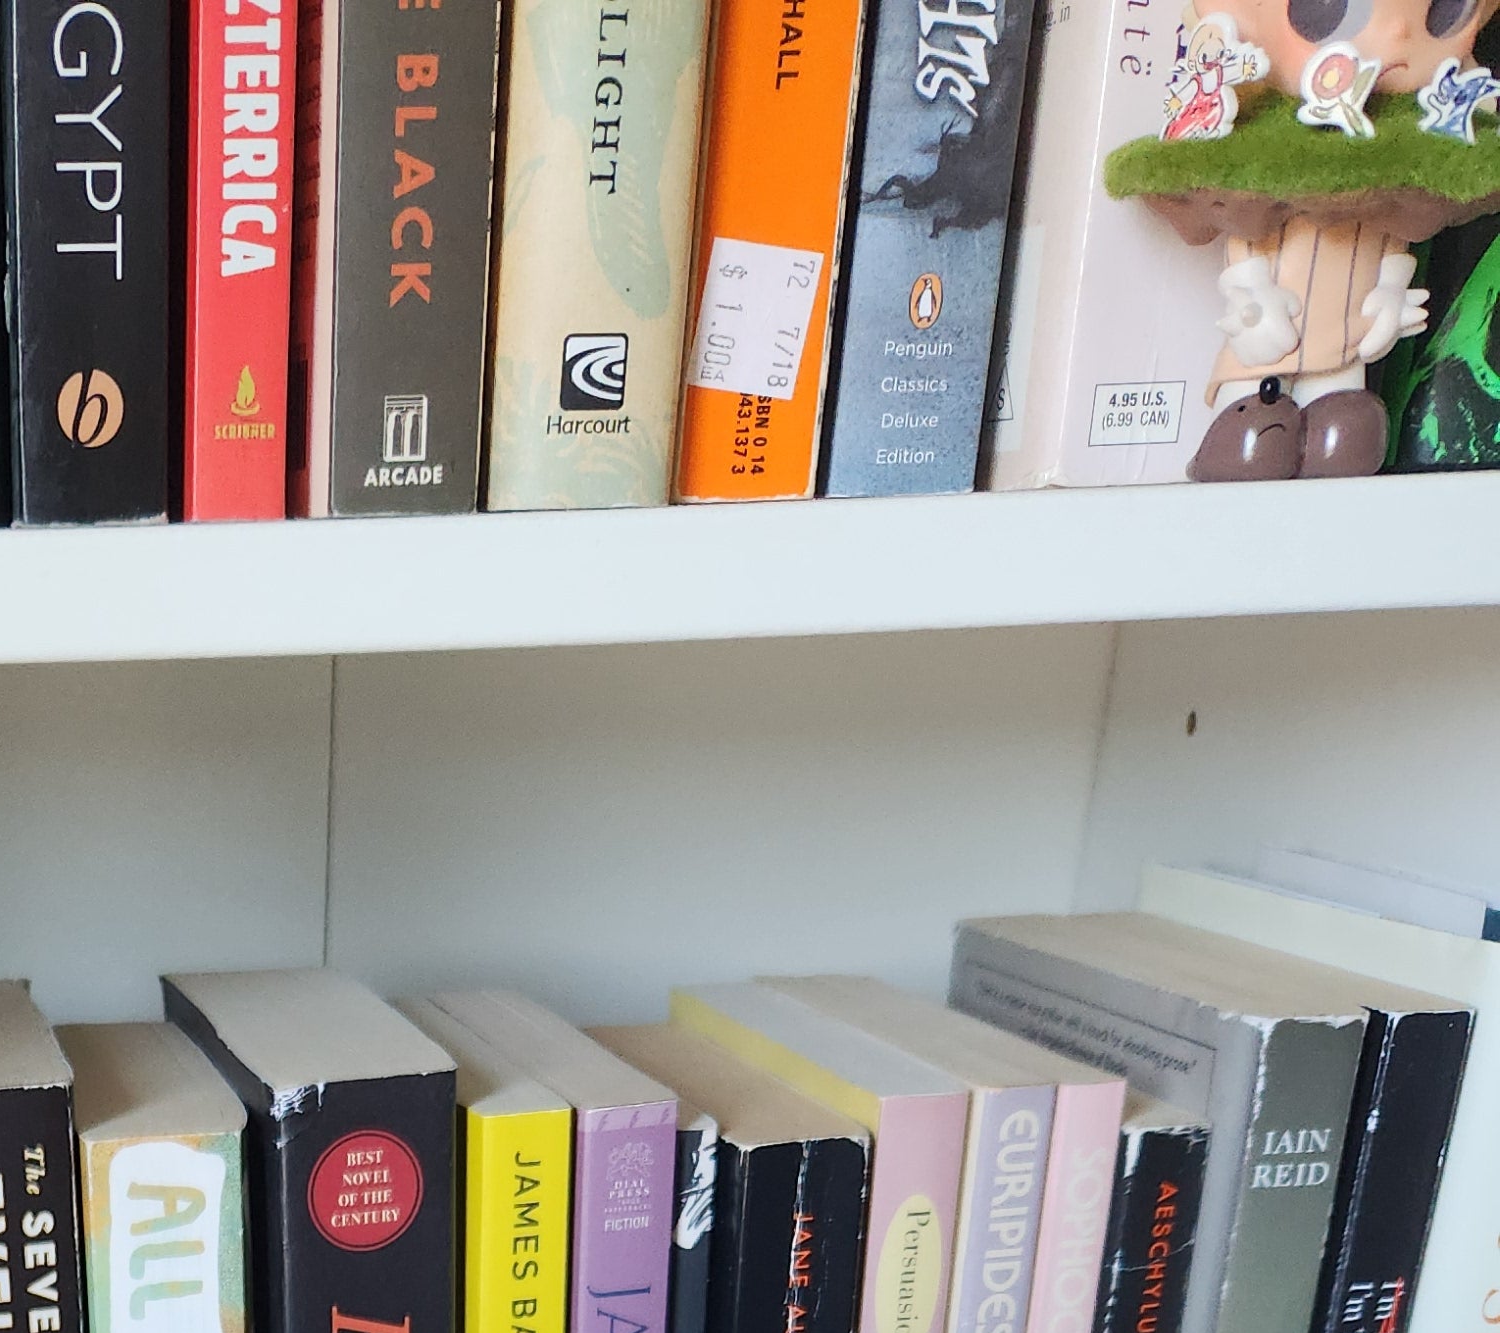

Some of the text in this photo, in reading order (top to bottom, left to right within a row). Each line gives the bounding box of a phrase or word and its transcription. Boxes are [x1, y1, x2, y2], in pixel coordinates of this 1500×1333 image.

[588, 9, 630, 195] LIGHT
[389, 54, 440, 308] BLACK
[766, 260, 817, 388] 72 7/18
[703, 303, 744, 367] 1.00
[884, 340, 954, 363] Penguin
[700, 366, 725, 383] EA
[881, 376, 949, 394] Classics
[1108, 391, 1168, 408] 4.95 U.S.
[546, 415, 631, 436] Harcourt
[881, 413, 939, 429] Deluxe
[1102, 410, 1170, 431] (6.99 CAN)
[213, 422, 276, 441] SCRIBNER
[750, 455, 766, 475] 14
[875, 449, 936, 467] Edition
[363, 464, 444, 488] ARCADE
[730, 464, 746, 475] 3
[1262, 1129, 1331, 1157] IAIN
[346, 1149, 385, 1168] BEST
[21, 1144, 46, 1197] The
[342, 1171, 393, 1186] NOVEL
[1251, 1161, 1331, 1190] REID
[338, 1189, 394, 1208] OF THE
[608, 1187, 651, 1200] PRESS
[330, 1208, 402, 1228] CENTURY
[511, 1151, 542, 1281] JAMES
[604, 1215, 650, 1232] FICTION
[125, 1180, 208, 1322] ALL
[789, 1212, 815, 1289] JANE
